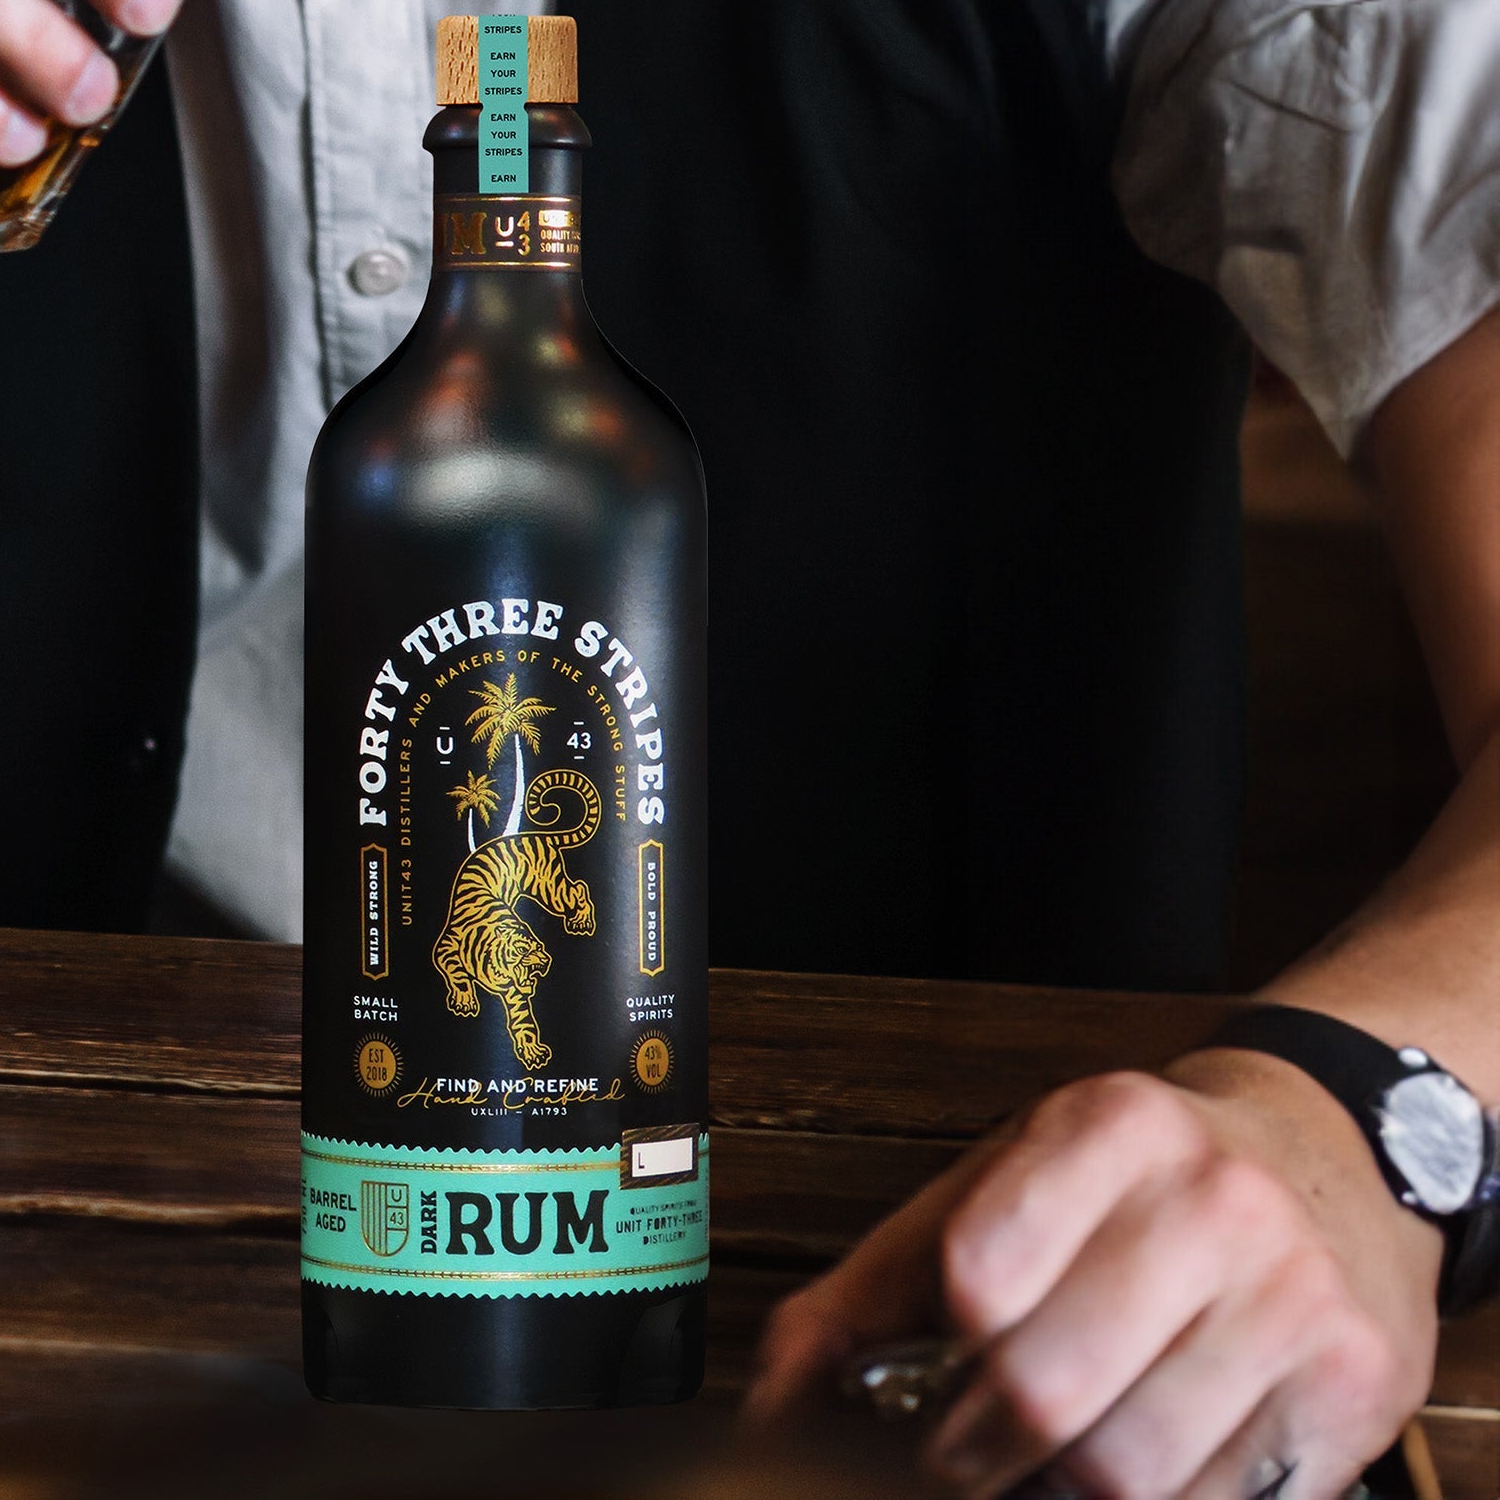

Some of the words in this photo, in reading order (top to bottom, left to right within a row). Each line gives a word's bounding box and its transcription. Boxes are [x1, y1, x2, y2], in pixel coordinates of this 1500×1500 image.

[484, 26, 522, 34] STRIPES
[490, 52, 516, 60] EARN
[490, 70, 516, 78] YOUR
[484, 87, 522, 95] STRIPES
[490, 113, 516, 121] EARN
[490, 131, 516, 139] YOUR
[484, 148, 523, 156] STRIPES
[491, 174, 516, 182] EARN
[359, 659, 409, 826] FORTY
[401, 598, 563, 665] THREE
[574, 621, 665, 825] STRIPES
[400, 738, 413, 846] DISTILLERS
[409, 692, 431, 728] AND
[435, 650, 506, 688] MAKERS
[518, 650, 538, 664] OF
[551, 657, 583, 684] THE
[587, 685, 624, 752] STRONG
[615, 765, 627, 821] STUFF
[436, 737, 454, 755] U
[566, 733, 592, 750] 43
[646, 862, 656, 901] BOLD
[369, 860, 379, 920] STRONG
[647, 910, 657, 962] PROUD
[369, 929, 380, 966] WILD
[353, 995, 398, 1009] SMALL
[626, 994, 675, 1009] QUALITY
[354, 1009, 398, 1021] BATCH
[629, 1008, 673, 1022] SPIRITS
[368, 1048, 385, 1063] EST
[366, 1066, 388, 1081] 2018
[645, 1063, 661, 1078] VOL
[436, 1078, 479, 1093] FIND
[486, 1079, 527, 1093] AND
[534, 1078, 599, 1093] REFINE
[531, 1107, 568, 1116] A1793
[310, 1188, 357, 1212] BARREL
[391, 1188, 402, 1202] U
[315, 1212, 346, 1232] AGED
[389, 1211, 405, 1226] 43
[420, 1190, 437, 1255] DARK
[445, 1190, 610, 1254] RUM
[615, 1219, 642, 1234] UNIT
[643, 1231, 686, 1245] DISTILLERY
